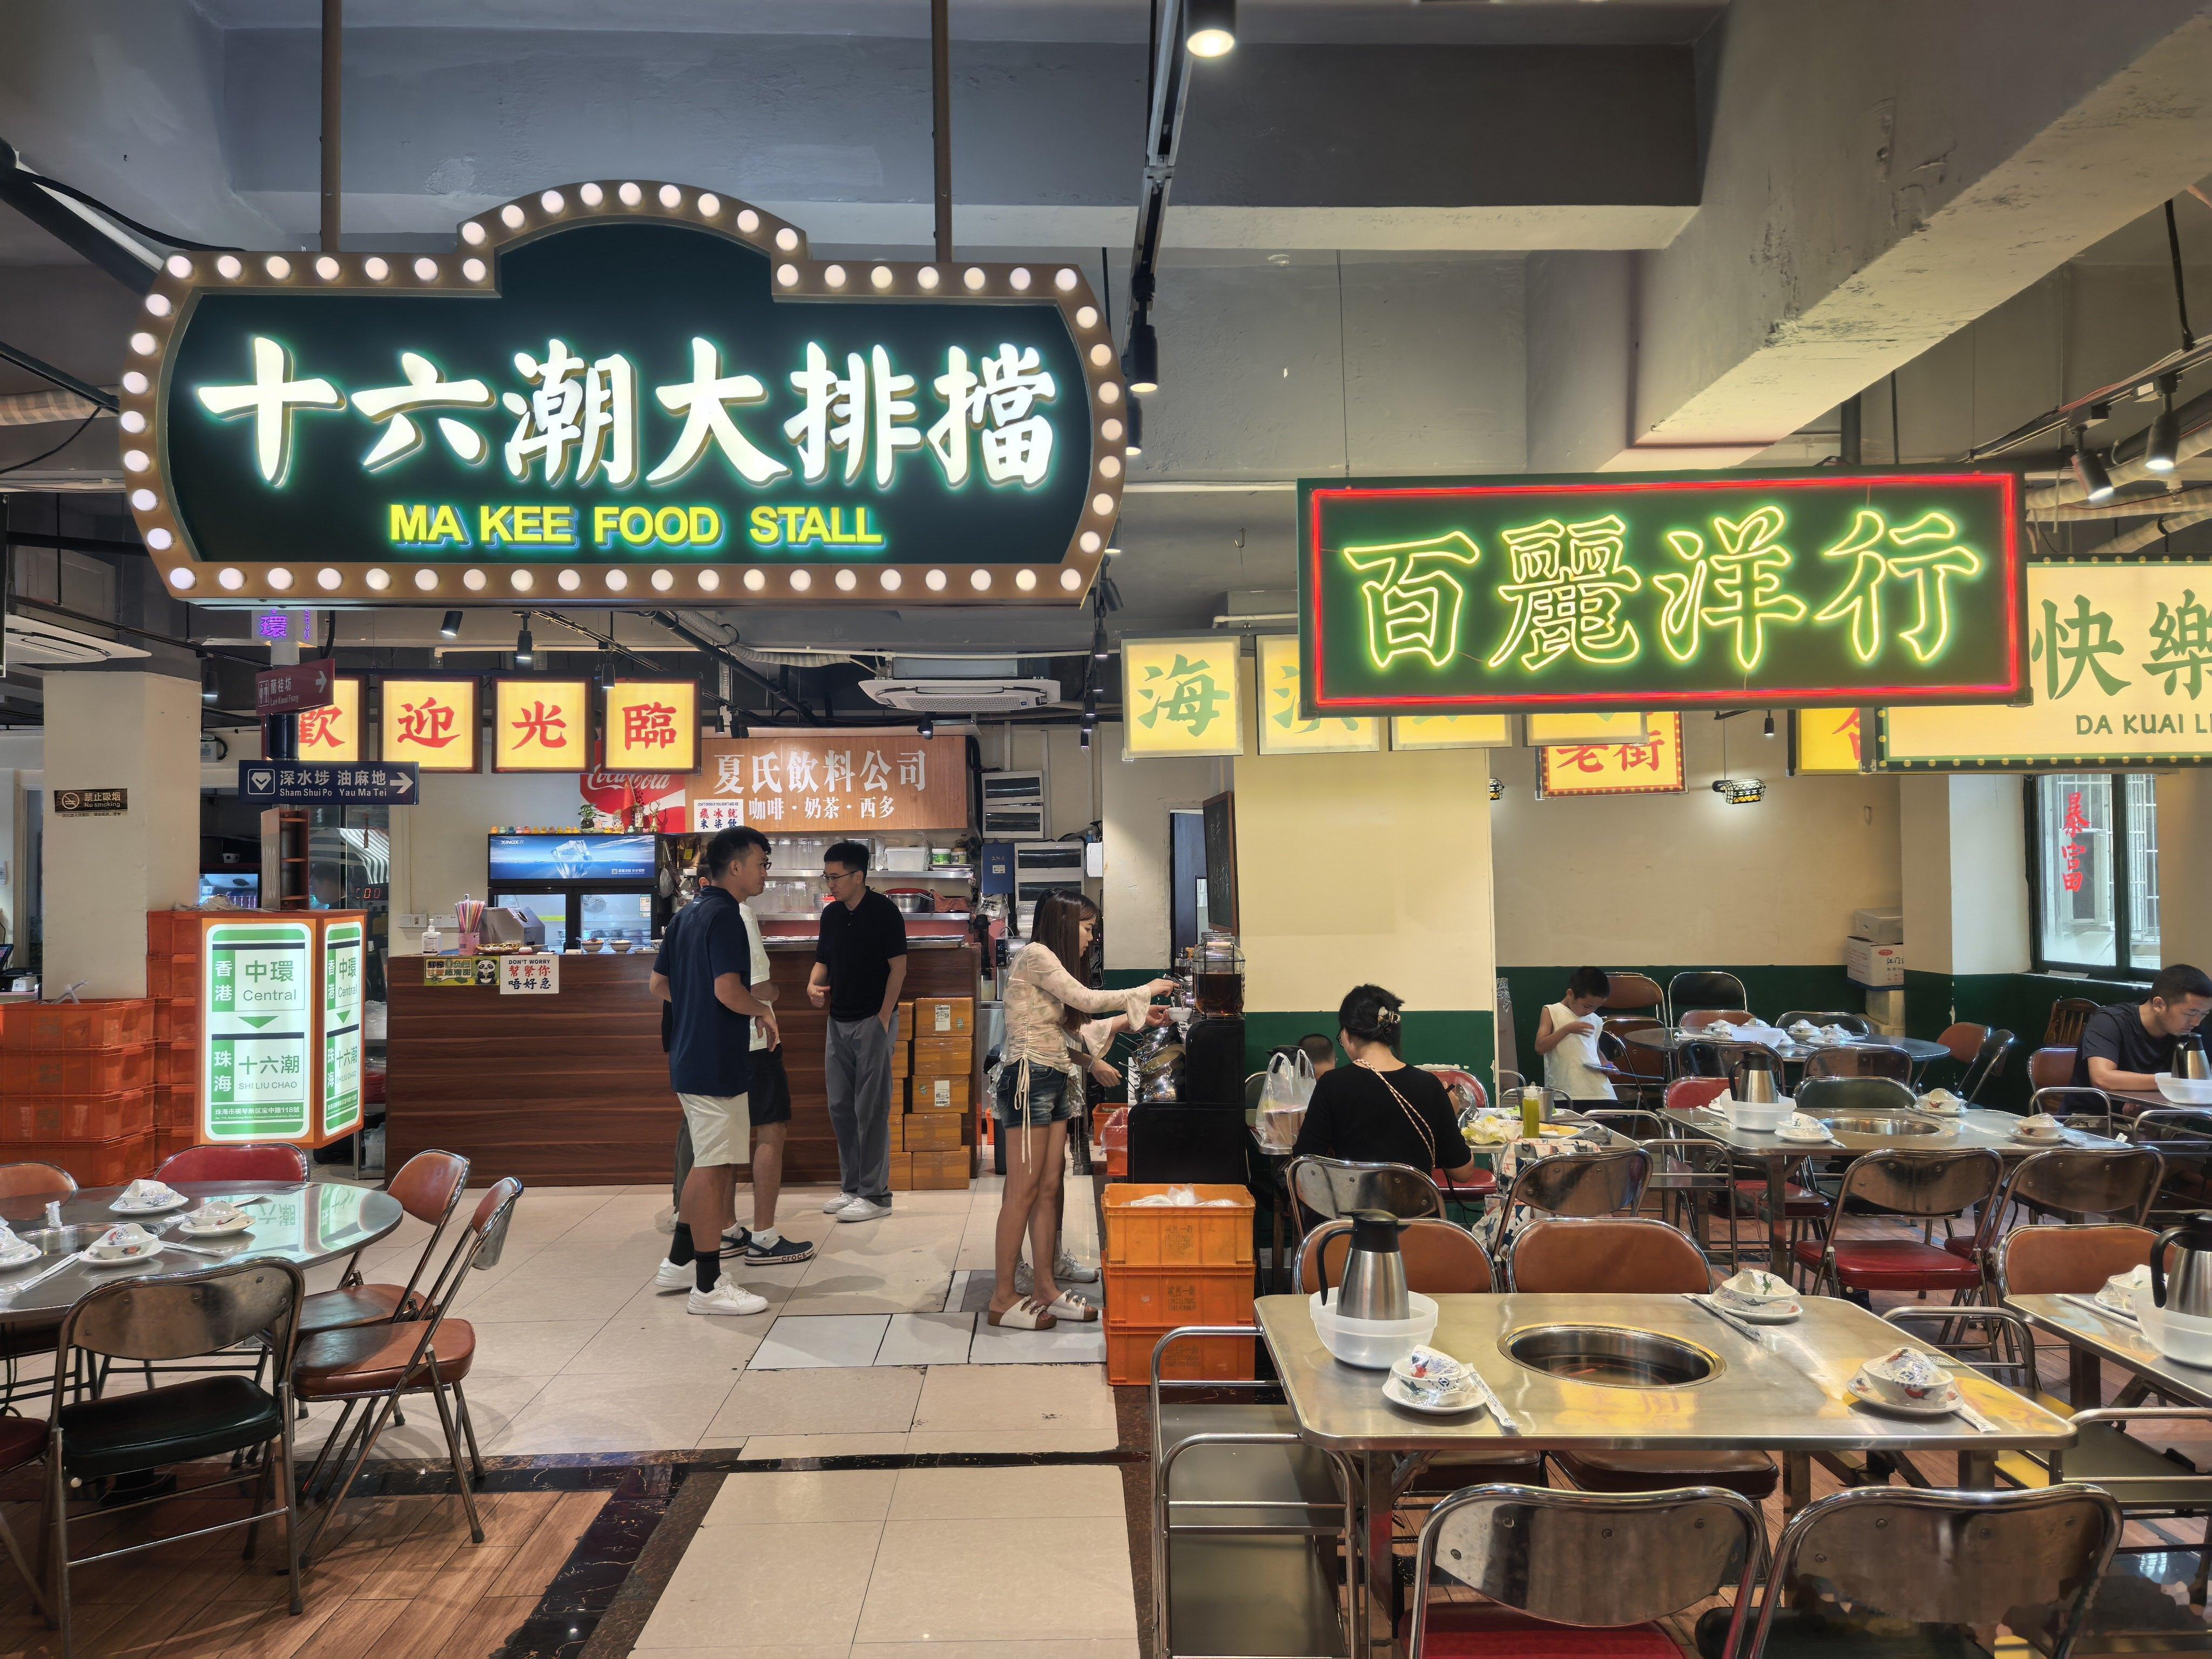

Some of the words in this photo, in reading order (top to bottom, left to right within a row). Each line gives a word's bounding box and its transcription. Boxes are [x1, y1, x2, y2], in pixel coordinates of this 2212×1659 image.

[198, 336, 1057, 488] 十六潮大排擋
[391, 505, 463, 542] MA
[481, 506, 572, 542] KEE
[595, 507, 720, 543] FOOD
[750, 506, 882, 543] STALL
[1343, 505, 1981, 671] 百麗洋行
[260, 609, 287, 638] 環
[2031, 588, 2212, 700] 快樂
[2076, 714, 2113, 735] DA
[2123, 714, 2184, 734] KUAI
[2195, 713, 2212, 733] L
[280, 770, 329, 786] 深水埗
[337, 770, 387, 786] 油麻地
[713, 750, 926, 795] 夏氏飲料公司
[84, 792, 120, 802] 禁止吸烟
[280, 788, 301, 797] Sham
[304, 788, 321, 797] Shui
[322, 788, 332, 797] Po
[339, 788, 355, 797] Yau
[358, 788, 371, 797] Ma
[373, 788, 387, 797] Tei
[245, 960, 294, 983] 中環
[339, 957, 356, 980] 中環
[214, 960, 232, 1001] 香港
[338, 983, 357, 997] Central
[508, 977, 551, 990] 唔好急
[243, 989, 296, 1001] Central
[239, 1054, 300, 1075] 十六潮
[336, 1046, 358, 1069] 十六潮
[214, 1050, 232, 1092] 珠海
[781, 1253, 806, 1262] crocs
